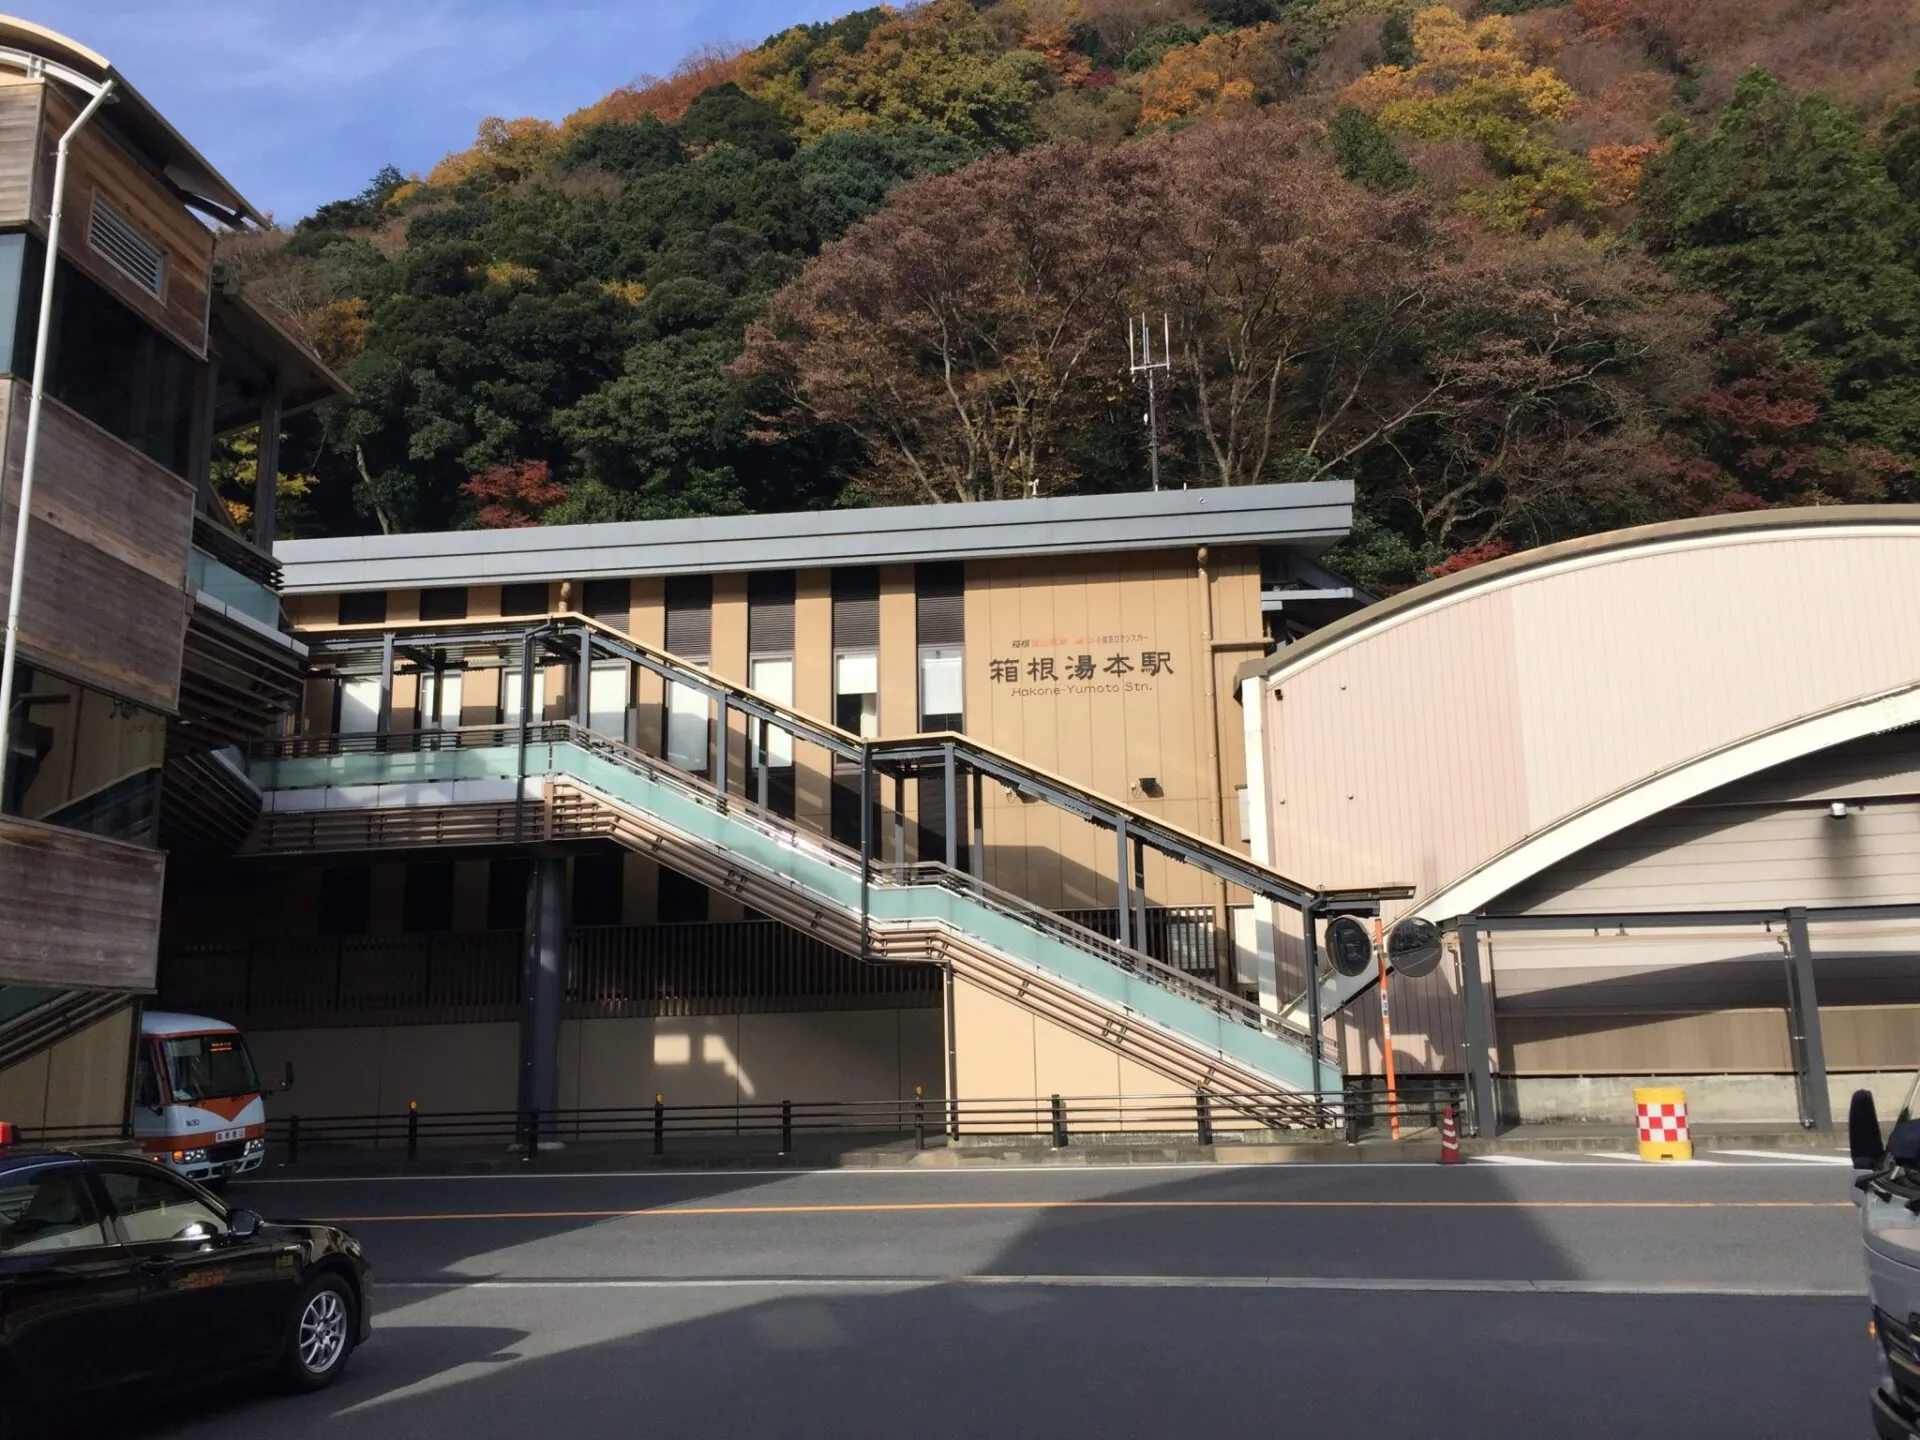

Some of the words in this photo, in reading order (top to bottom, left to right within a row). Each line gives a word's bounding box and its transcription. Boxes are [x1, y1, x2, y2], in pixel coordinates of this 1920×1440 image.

[989, 651, 1174, 684] 箱根湯本駅
[1011, 684, 1120, 697] Hakone-Yumoto
[1125, 681, 1153, 692] Stn.
